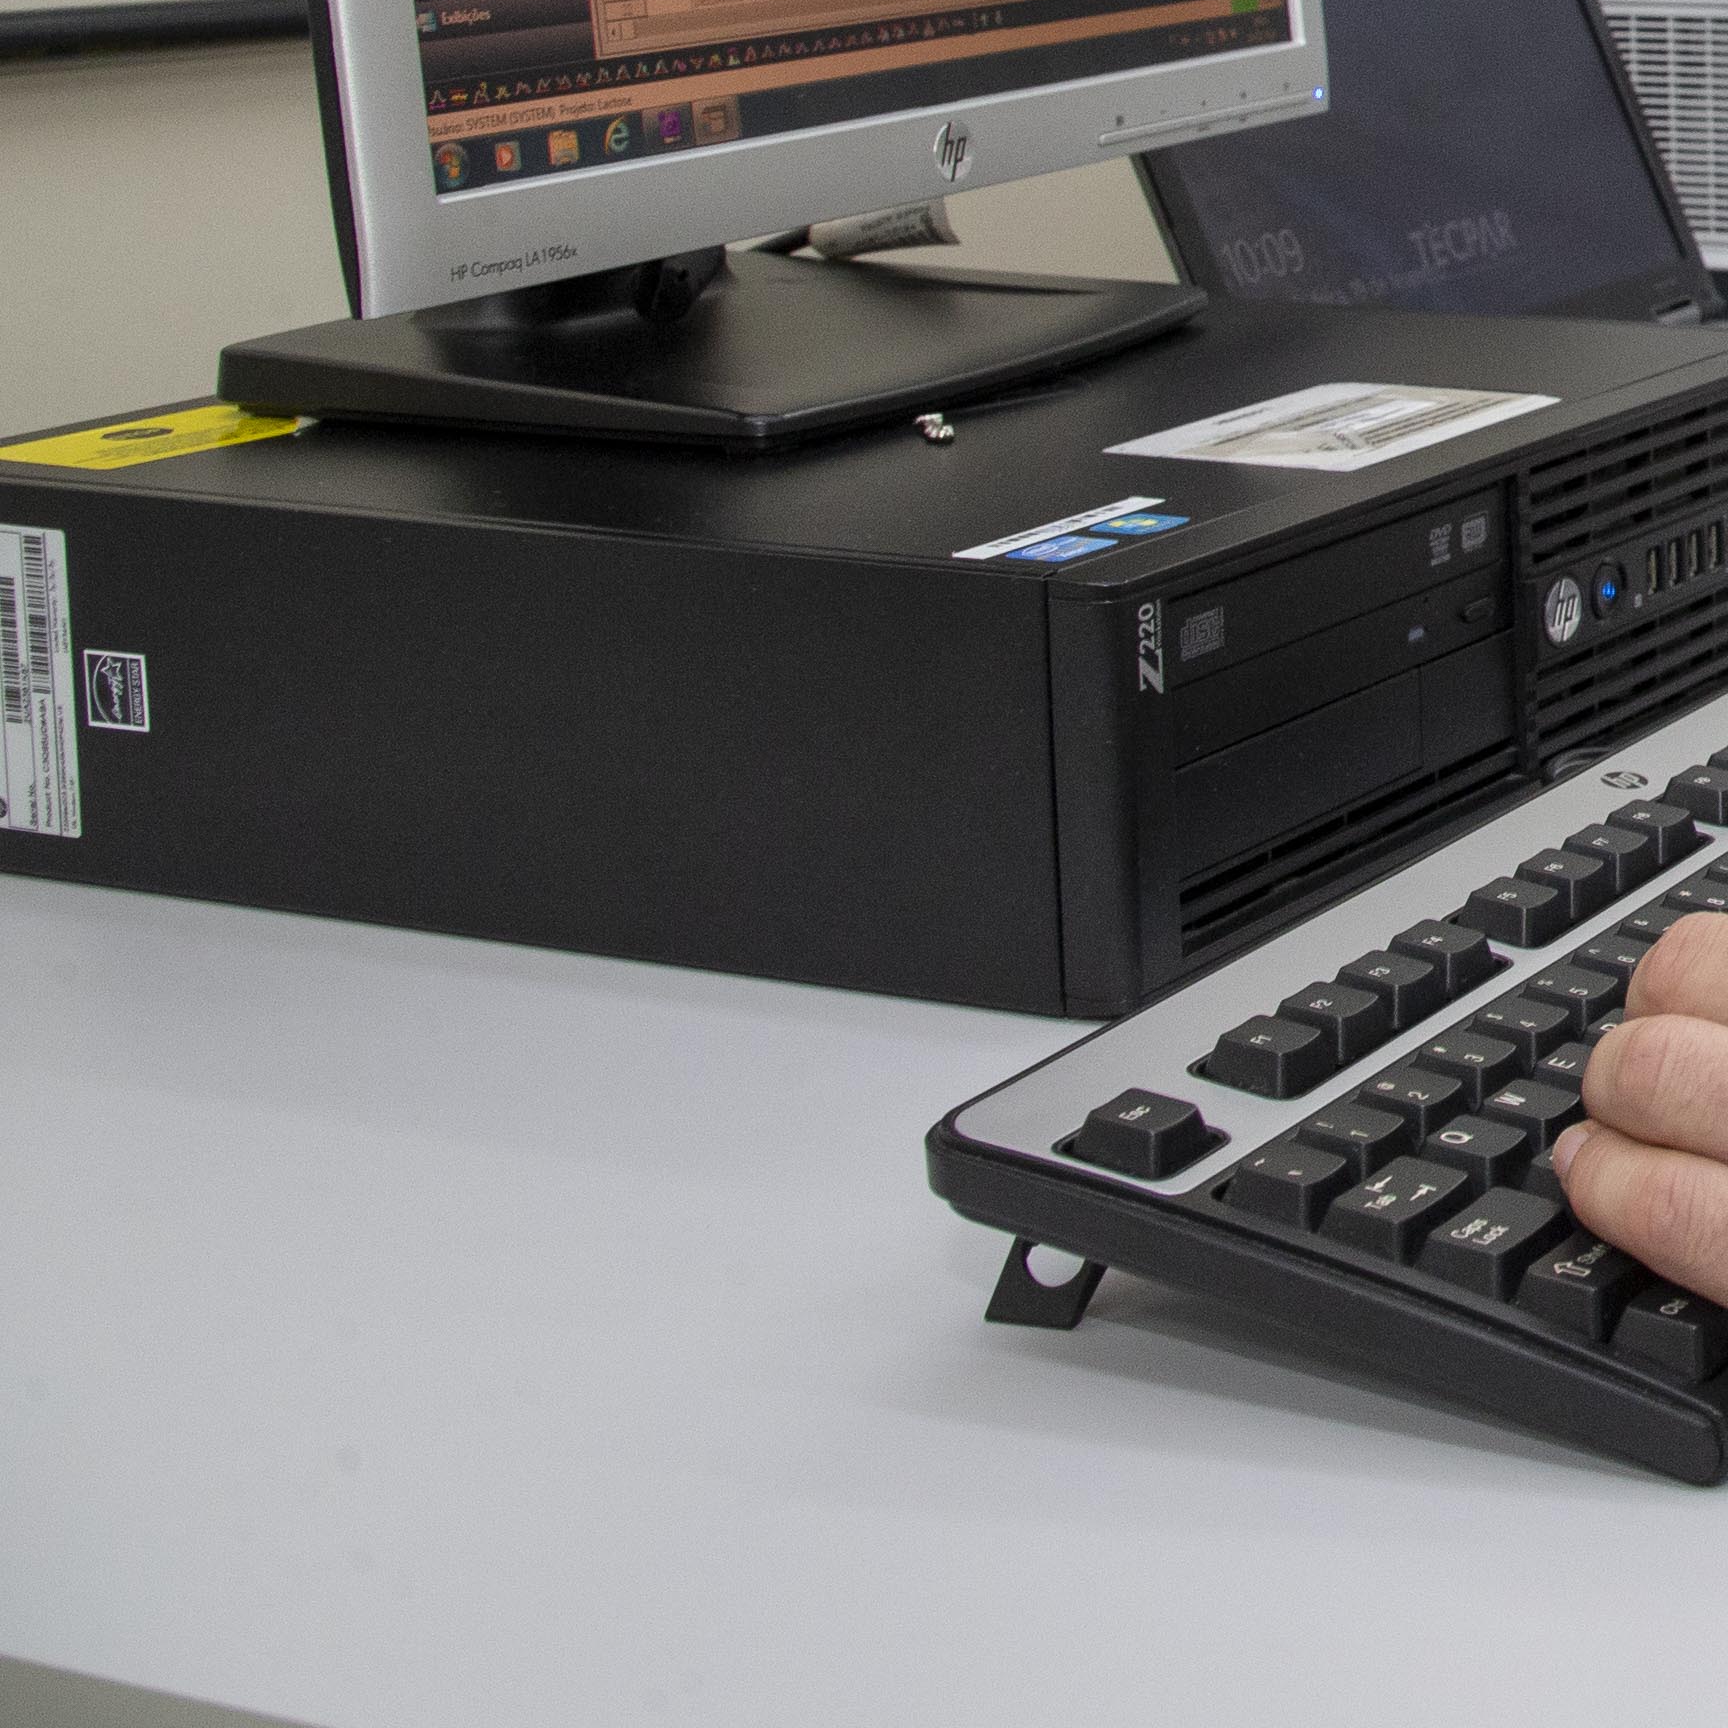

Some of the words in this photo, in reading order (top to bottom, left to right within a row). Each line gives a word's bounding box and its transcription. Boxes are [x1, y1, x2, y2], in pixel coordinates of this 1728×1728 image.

[466, 113, 507, 131] SYSTEM
[450, 265, 471, 283] HP
[471, 254, 523, 282] Compaq
[1138, 601, 1164, 695] Z220
[130, 661, 142, 687] STAR
[132, 688, 144, 724] ENERGY
[1495, 890, 1519, 903] F5
[1421, 934, 1444, 946] F4
[1367, 965, 1391, 979] F3
[1568, 986, 1589, 998] 5
[1308, 997, 1334, 1010] F2
[1519, 1019, 1537, 1029] 4
[1249, 1033, 1273, 1046] F1
[1463, 1053, 1485, 1064] 3
[1546, 1055, 1578, 1071] E
[1407, 1090, 1431, 1102] 2
[1493, 1092, 1527, 1107] W
[1118, 1104, 1151, 1122] Esc
[1350, 1129, 1370, 1139] 1
[1438, 1130, 1475, 1145] Q
[1363, 1193, 1398, 1211] Tab
[1450, 1217, 1490, 1240] Caps
[1471, 1224, 1510, 1246] Lock
